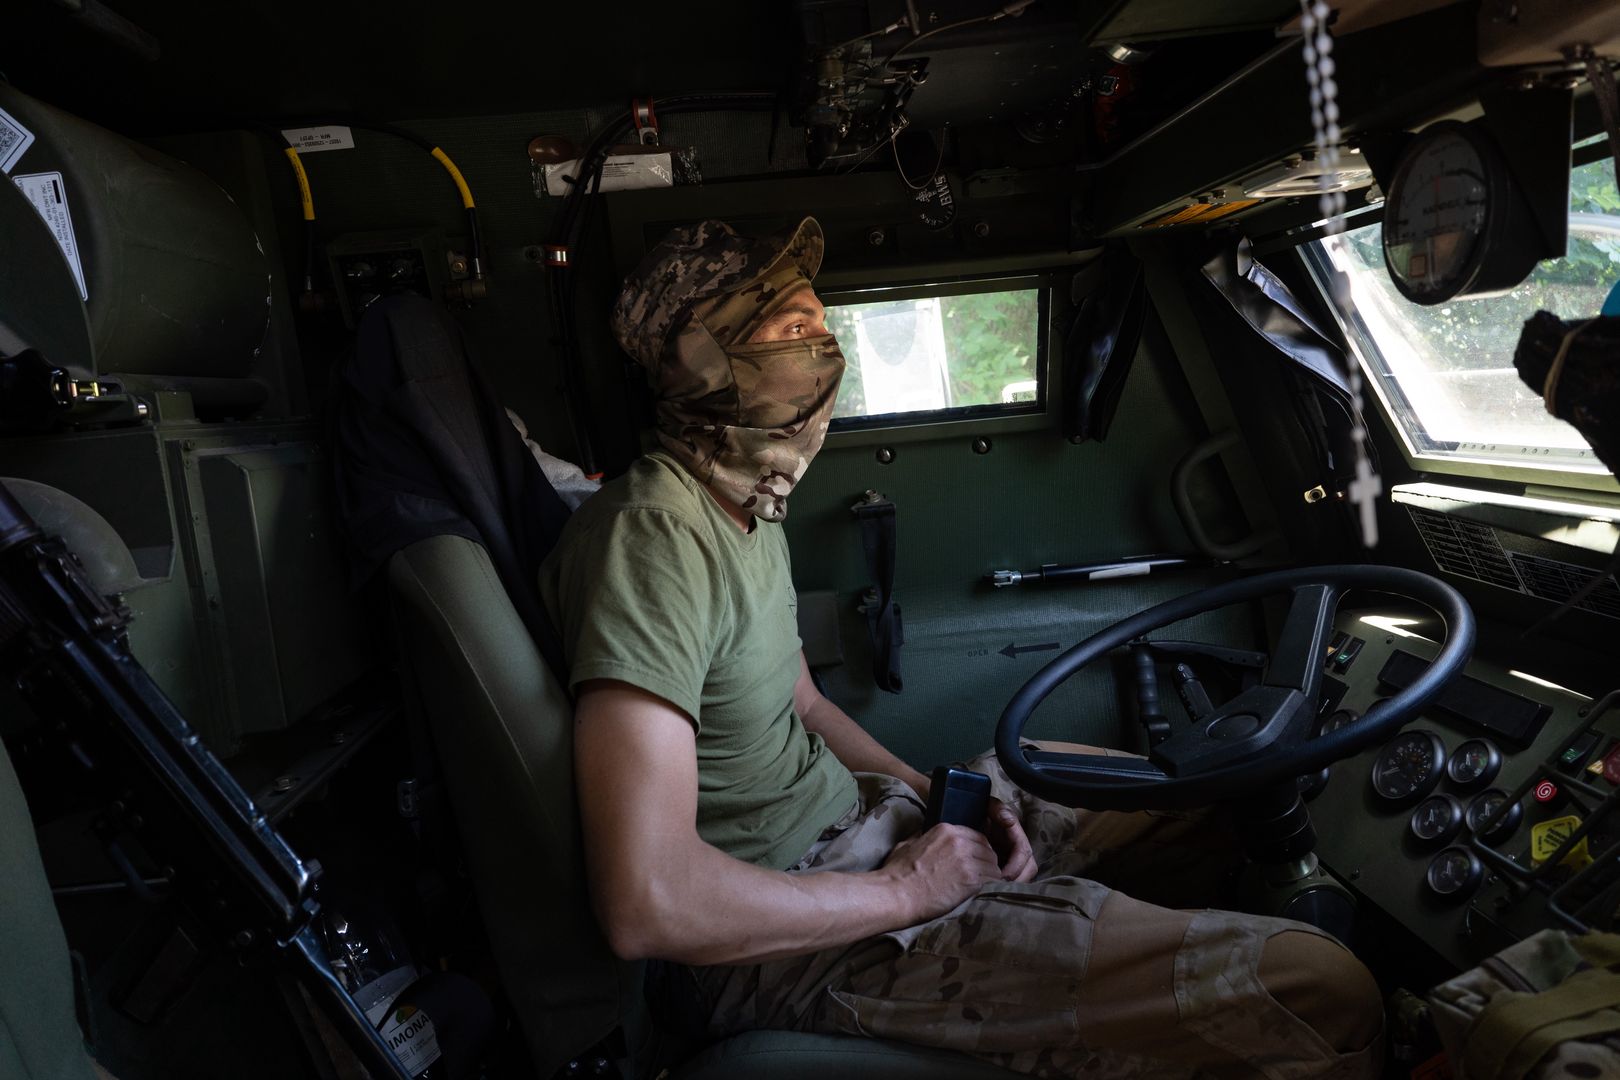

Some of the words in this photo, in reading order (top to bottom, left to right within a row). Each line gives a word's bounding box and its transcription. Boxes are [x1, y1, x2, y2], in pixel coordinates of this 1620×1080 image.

[59, 211, 69, 240] INSTALLED
[65, 242, 73, 256] DATE
[388, 1014, 431, 1050] IMONA
